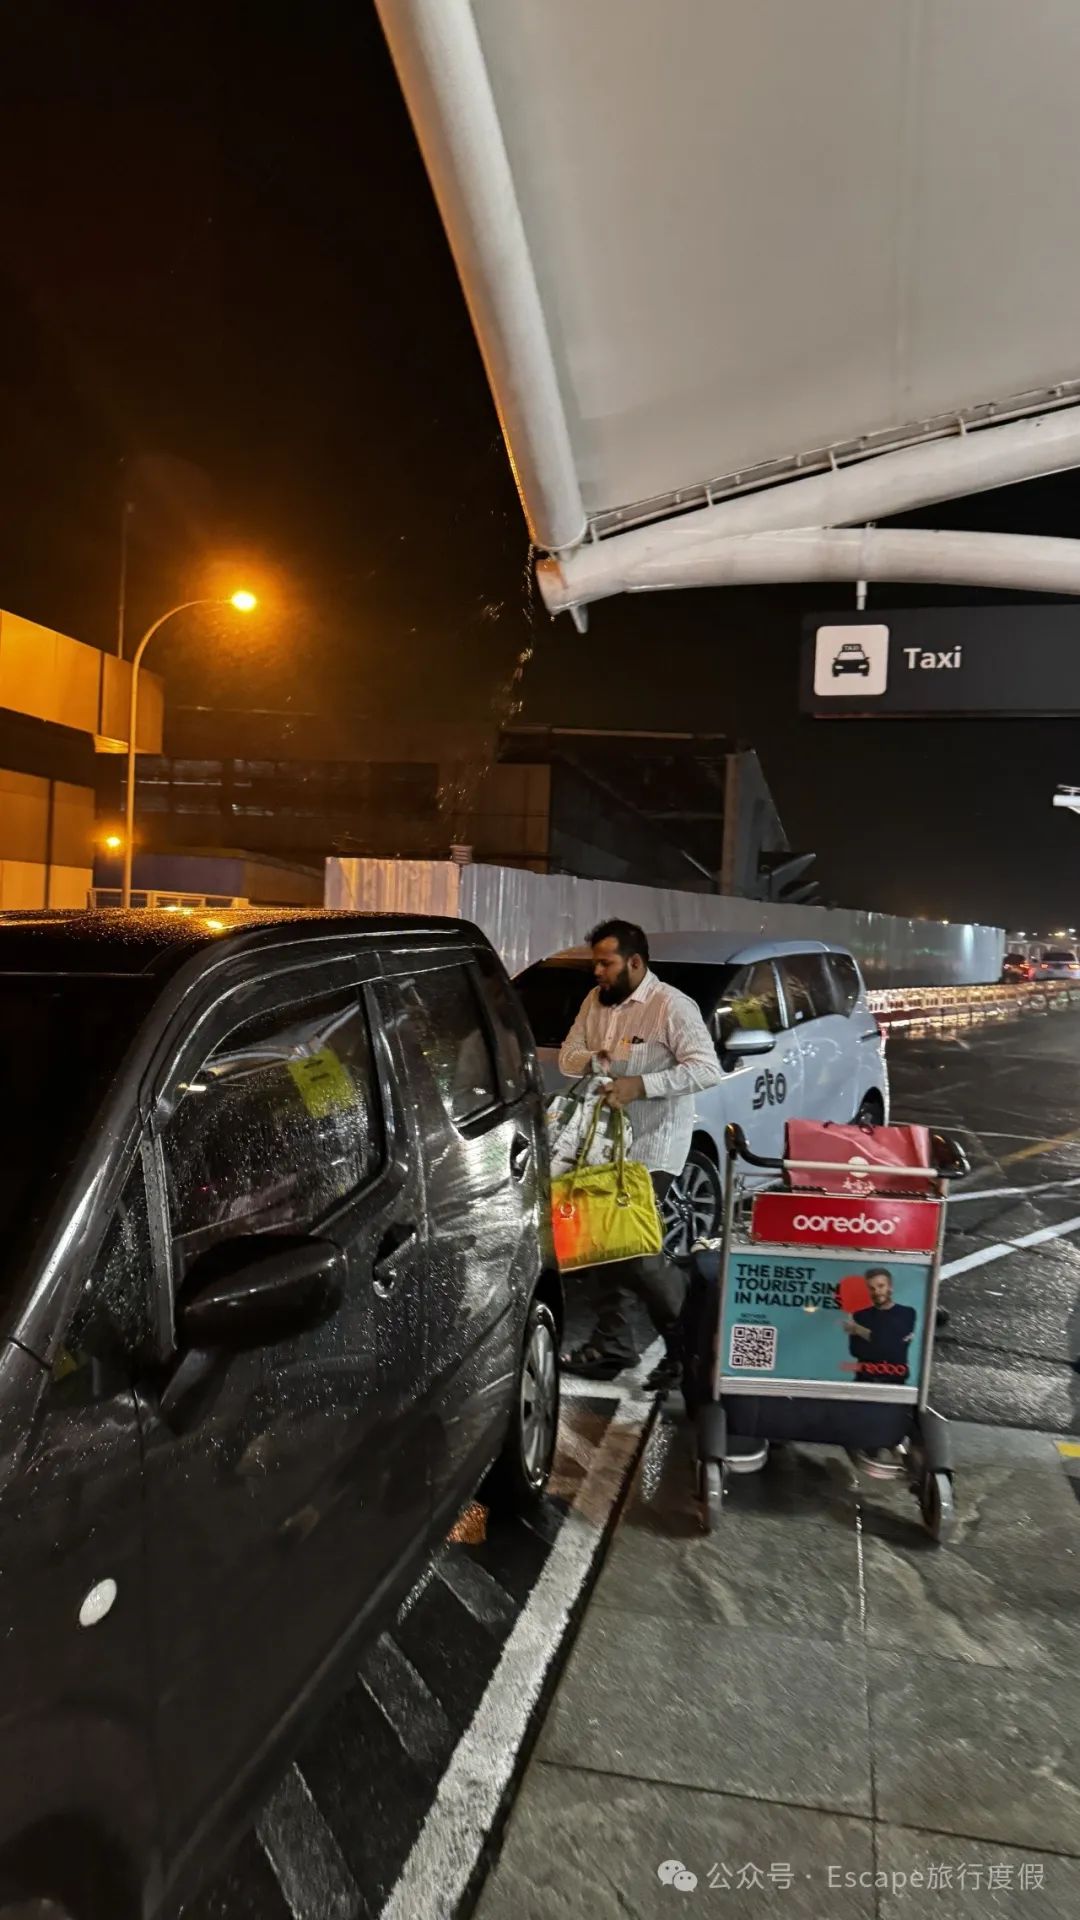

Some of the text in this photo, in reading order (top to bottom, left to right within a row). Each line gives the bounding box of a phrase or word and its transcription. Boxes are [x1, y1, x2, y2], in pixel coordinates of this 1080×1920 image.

[903, 646, 962, 669] Taxi
[793, 1213, 896, 1235] ooredoo
[737, 1264, 816, 1280] THE BEST
[736, 1278, 842, 1296] TOURIST SIM
[734, 1292, 843, 1310] IN MALDIVES
